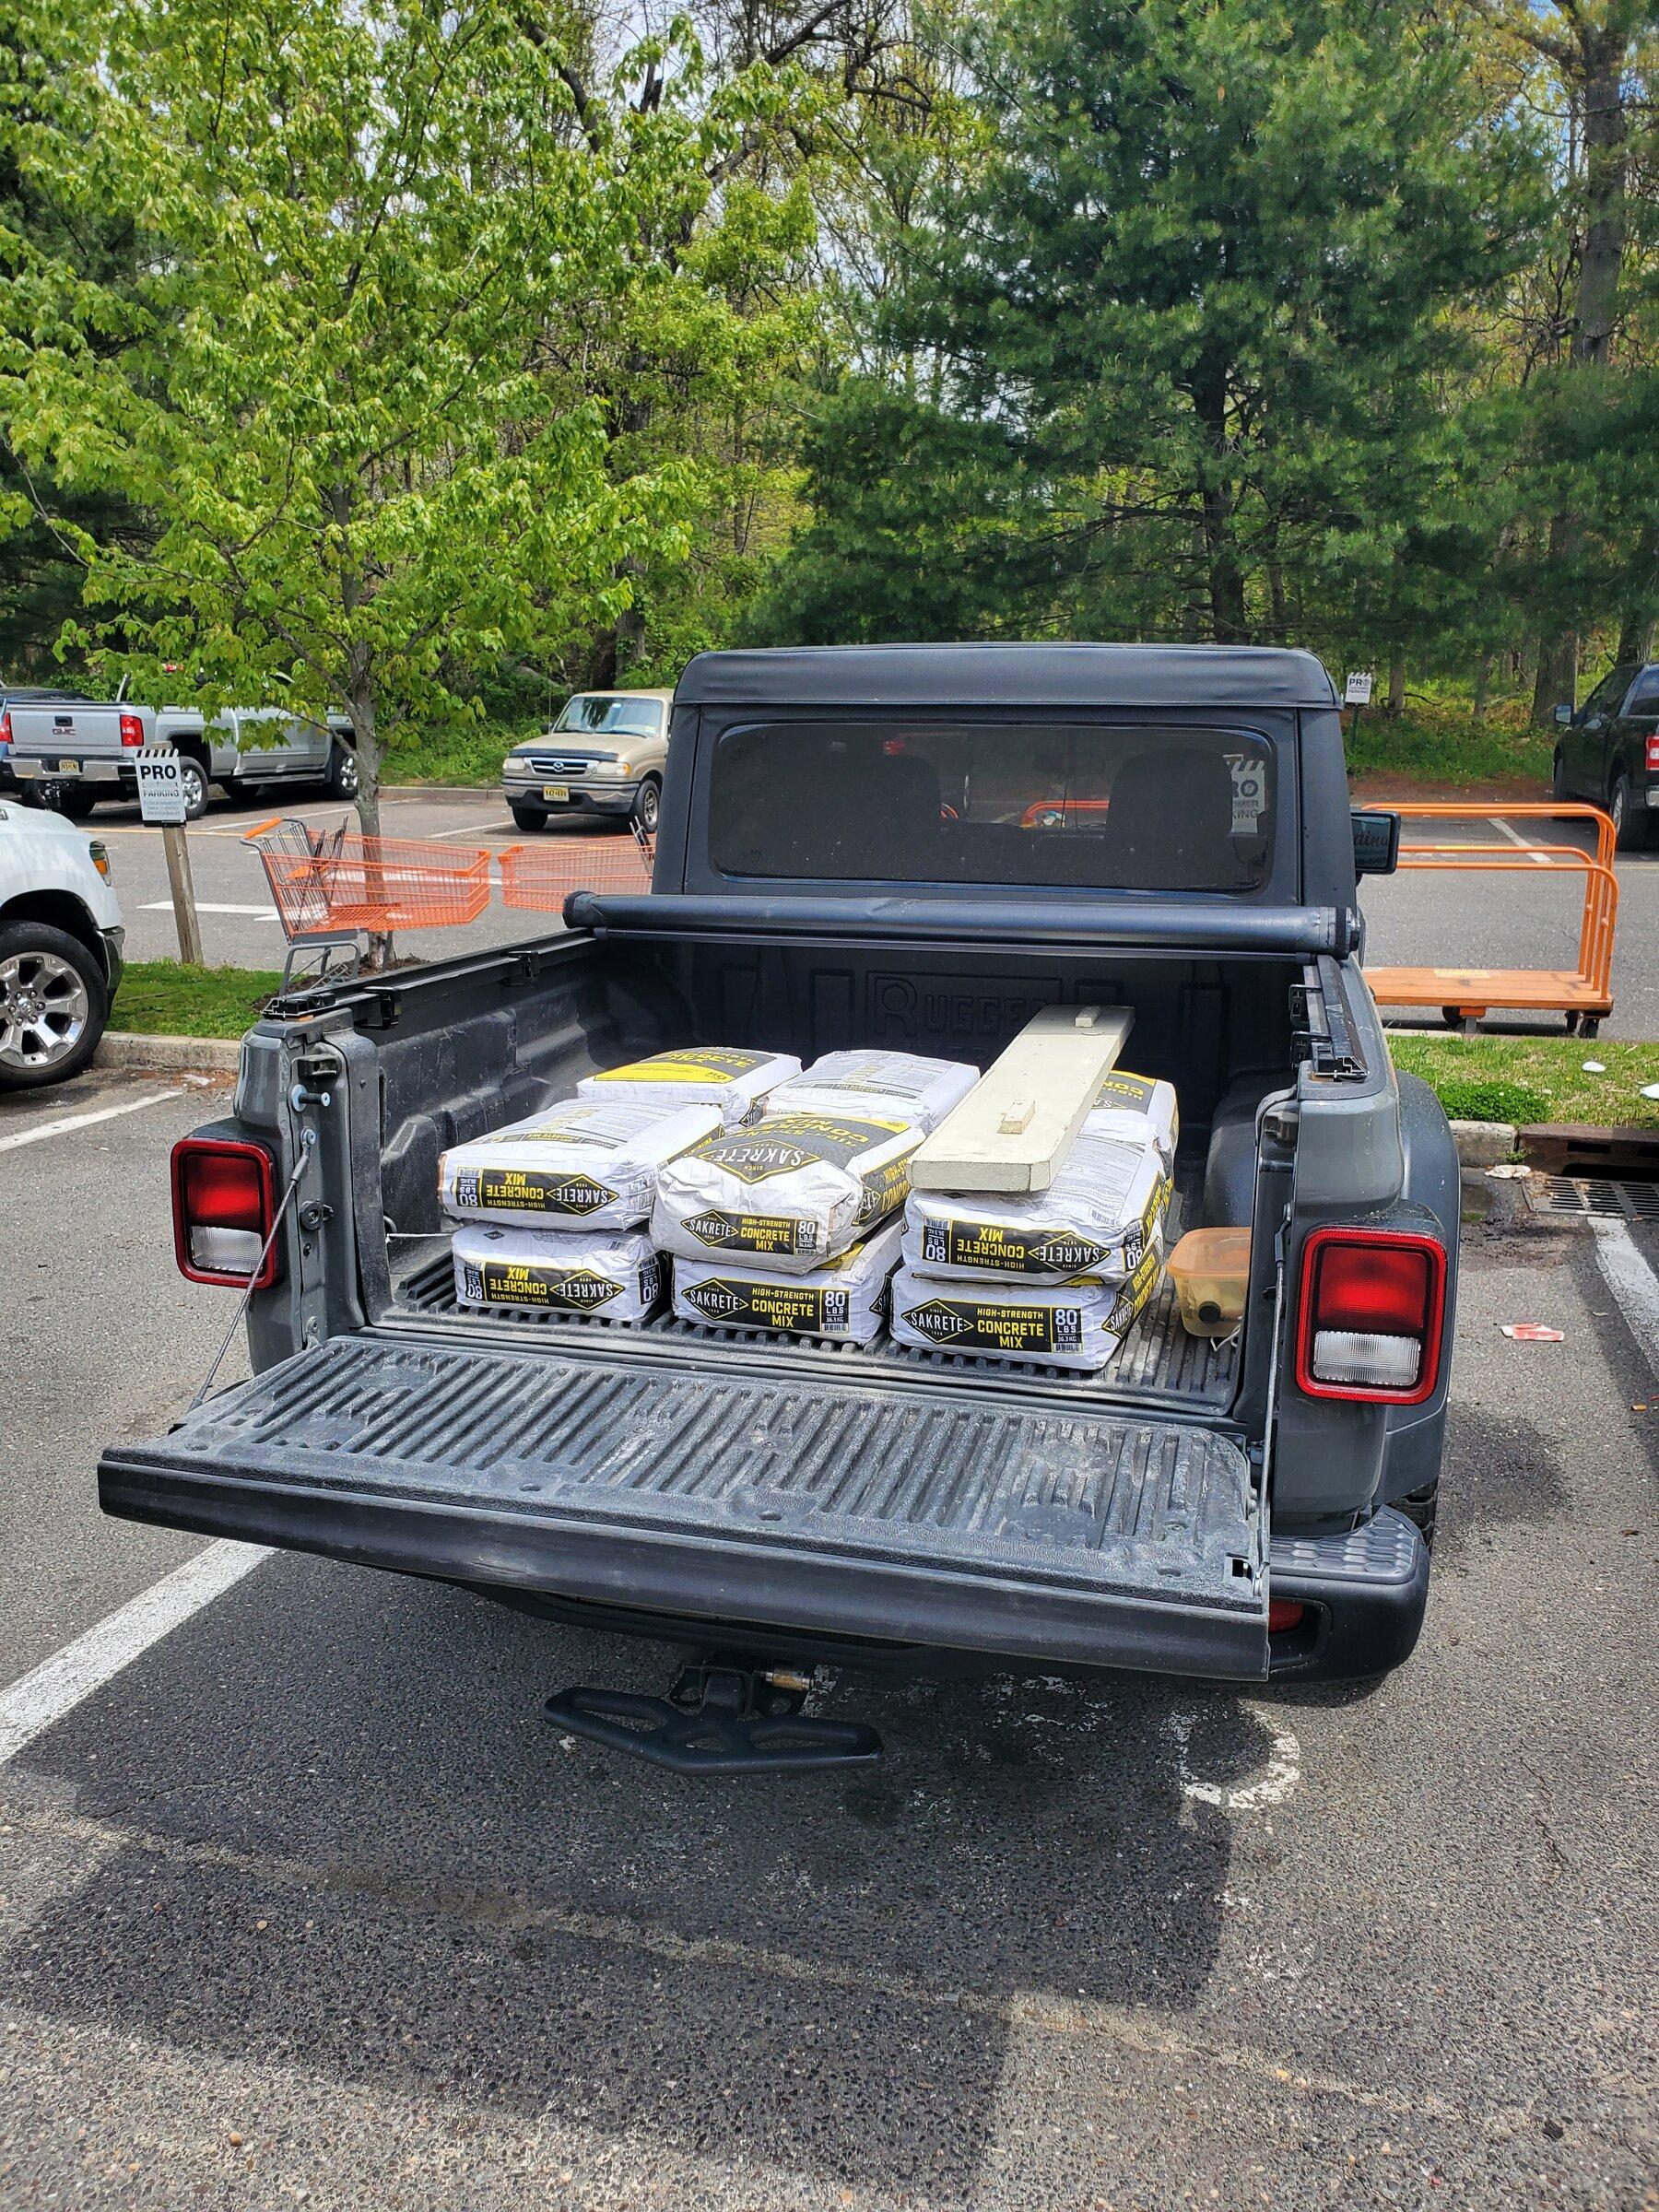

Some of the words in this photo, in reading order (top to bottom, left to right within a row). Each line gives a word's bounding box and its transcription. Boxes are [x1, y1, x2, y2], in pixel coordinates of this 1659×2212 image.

[140, 765, 176, 780] PRO
[143, 790, 180, 798] PARKING
[875, 976, 1046, 1037] RUGGE
[712, 1148, 806, 1166] SAKRETE
[505, 1172, 526, 1185] MIX
[486, 1184, 544, 1200] CONCRETE
[556, 1187, 608, 1204] SAKRETE
[460, 1194, 478, 1206] 80
[487, 1199, 546, 1209] HIGH-STRENGTH
[689, 1219, 731, 1237] SAKRETE
[741, 1218, 791, 1229] HIGH-STRENGTH
[798, 1221, 816, 1234] 80
[740, 1227, 790, 1241] CONCRETE
[928, 1237, 945, 1245] LBS
[979, 1227, 1004, 1241] MIX
[756, 1240, 774, 1252] MIX
[925, 1244, 946, 1262] 80
[957, 1240, 1025, 1259] CONCRETE
[1124, 1241, 1143, 1252] LBS
[1039, 1245, 1100, 1263] SAKRETE
[957, 1254, 1025, 1270] HIGH-STRENGTH
[508, 1267, 529, 1281] MIX
[643, 1275, 658, 1286] LBS
[467, 1277, 481, 1286] LBS
[489, 1277, 547, 1295] CONCRETE
[466, 1286, 483, 1300] 80
[558, 1282, 614, 1298] SAKRETE
[644, 1283, 659, 1301] 80
[752, 1288, 814, 1301] HIGH-STRENGTH
[491, 1292, 549, 1304] HIGH-STRENGTH
[690, 1289, 739, 1312] SAKRETE
[824, 1291, 846, 1307] 80
[751, 1299, 814, 1317] CONCRETE
[977, 1308, 1043, 1320] HIGH-STRENGTH
[771, 1315, 794, 1328] MIX
[911, 1312, 964, 1333] SAKRETE
[1055, 1309, 1077, 1325] 80
[977, 1319, 1044, 1336] CONCRETE
[1056, 1325, 1077, 1334] LBS
[999, 1336, 1023, 1349] MIX
